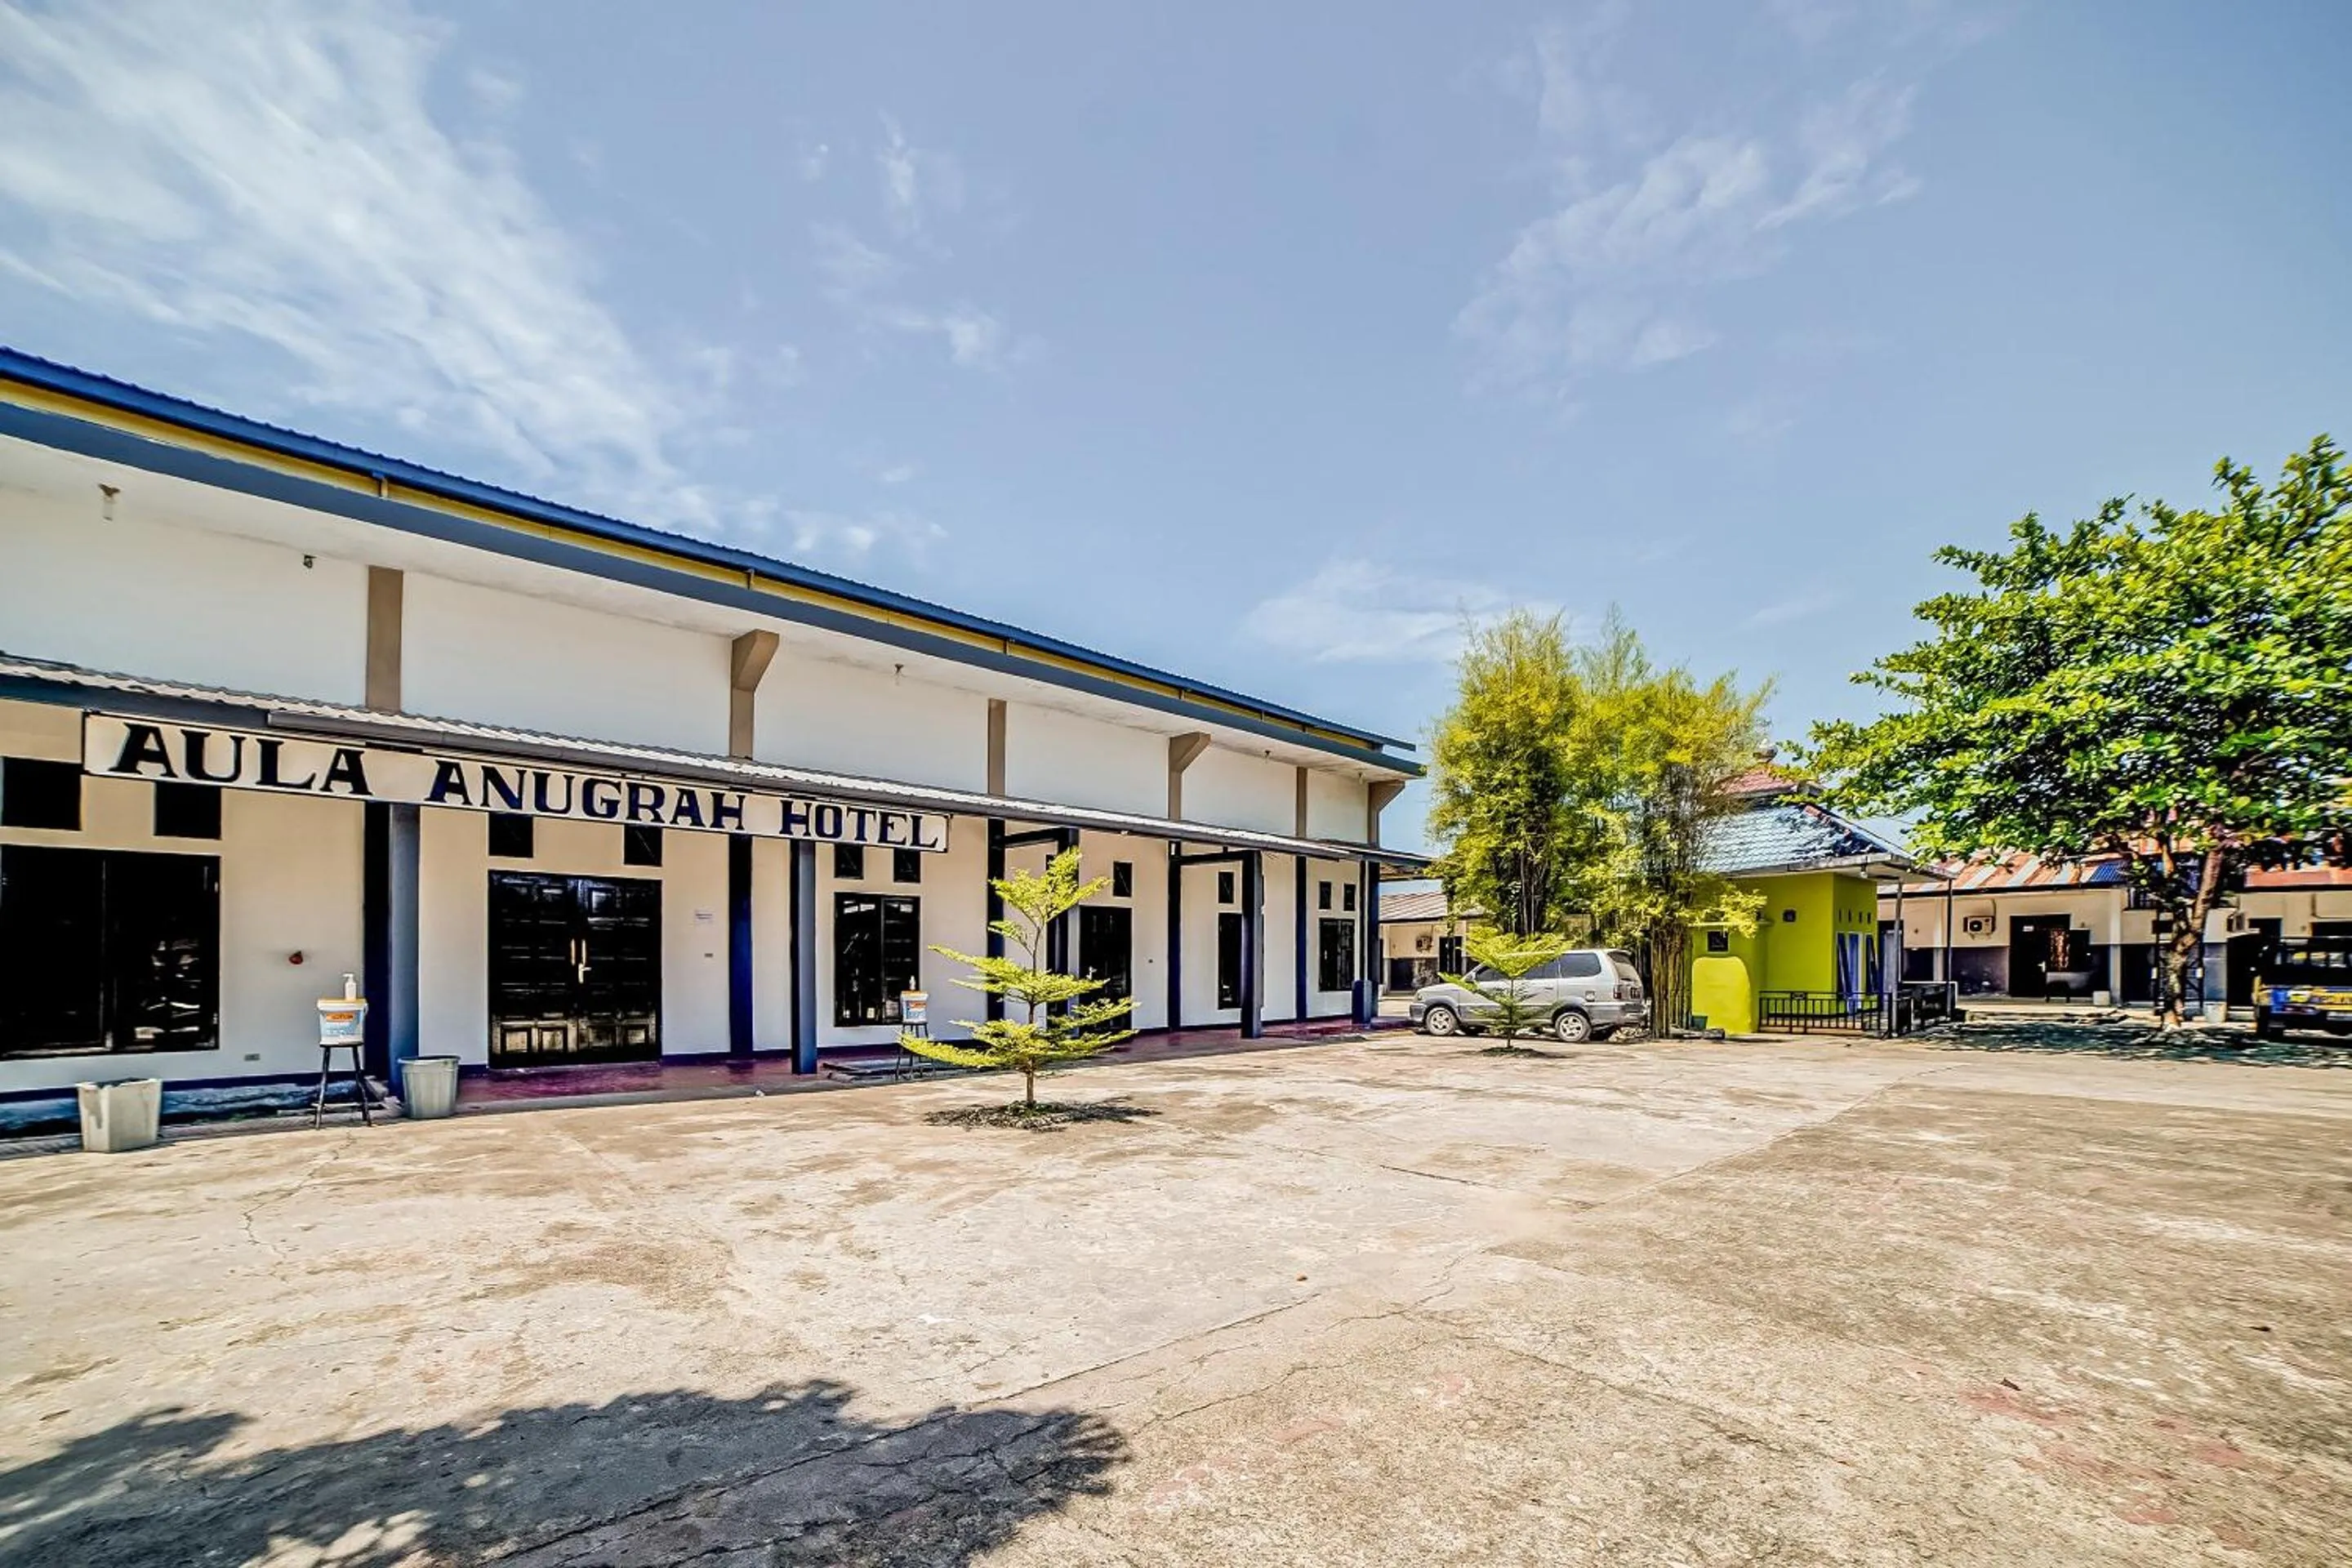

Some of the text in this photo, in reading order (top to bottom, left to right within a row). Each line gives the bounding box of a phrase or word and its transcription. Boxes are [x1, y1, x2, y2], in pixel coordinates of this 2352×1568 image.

[108, 722, 938, 849] AULA ANUGRAH HOTEL
